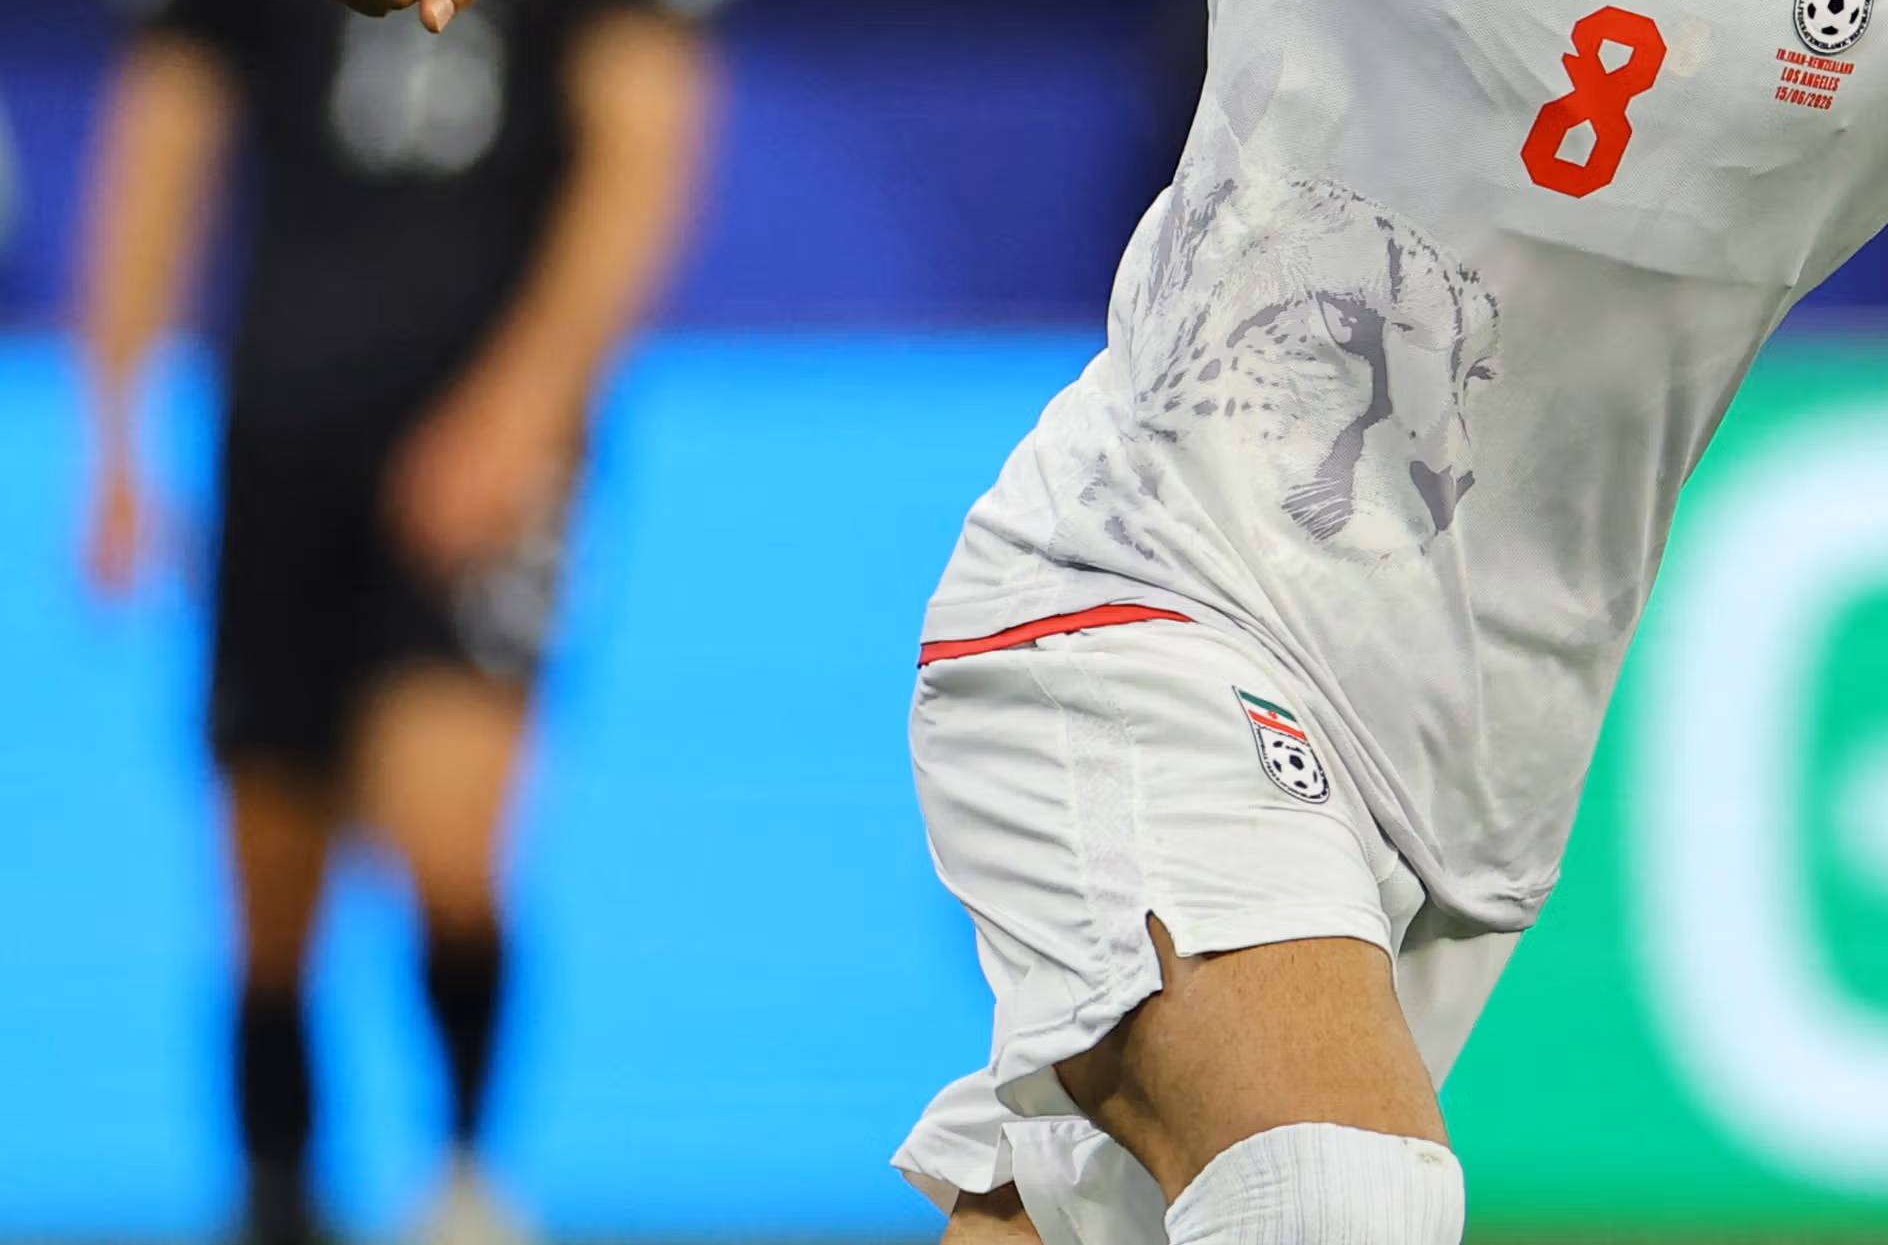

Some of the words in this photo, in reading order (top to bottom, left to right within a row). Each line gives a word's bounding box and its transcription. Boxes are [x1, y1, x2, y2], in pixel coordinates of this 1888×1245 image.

[1781, 67, 1801, 84] LOS
[1800, 71, 1840, 92] ANGELES
[1521, 6, 1667, 197] 8
[1775, 86, 1833, 110] 15/06/2026
